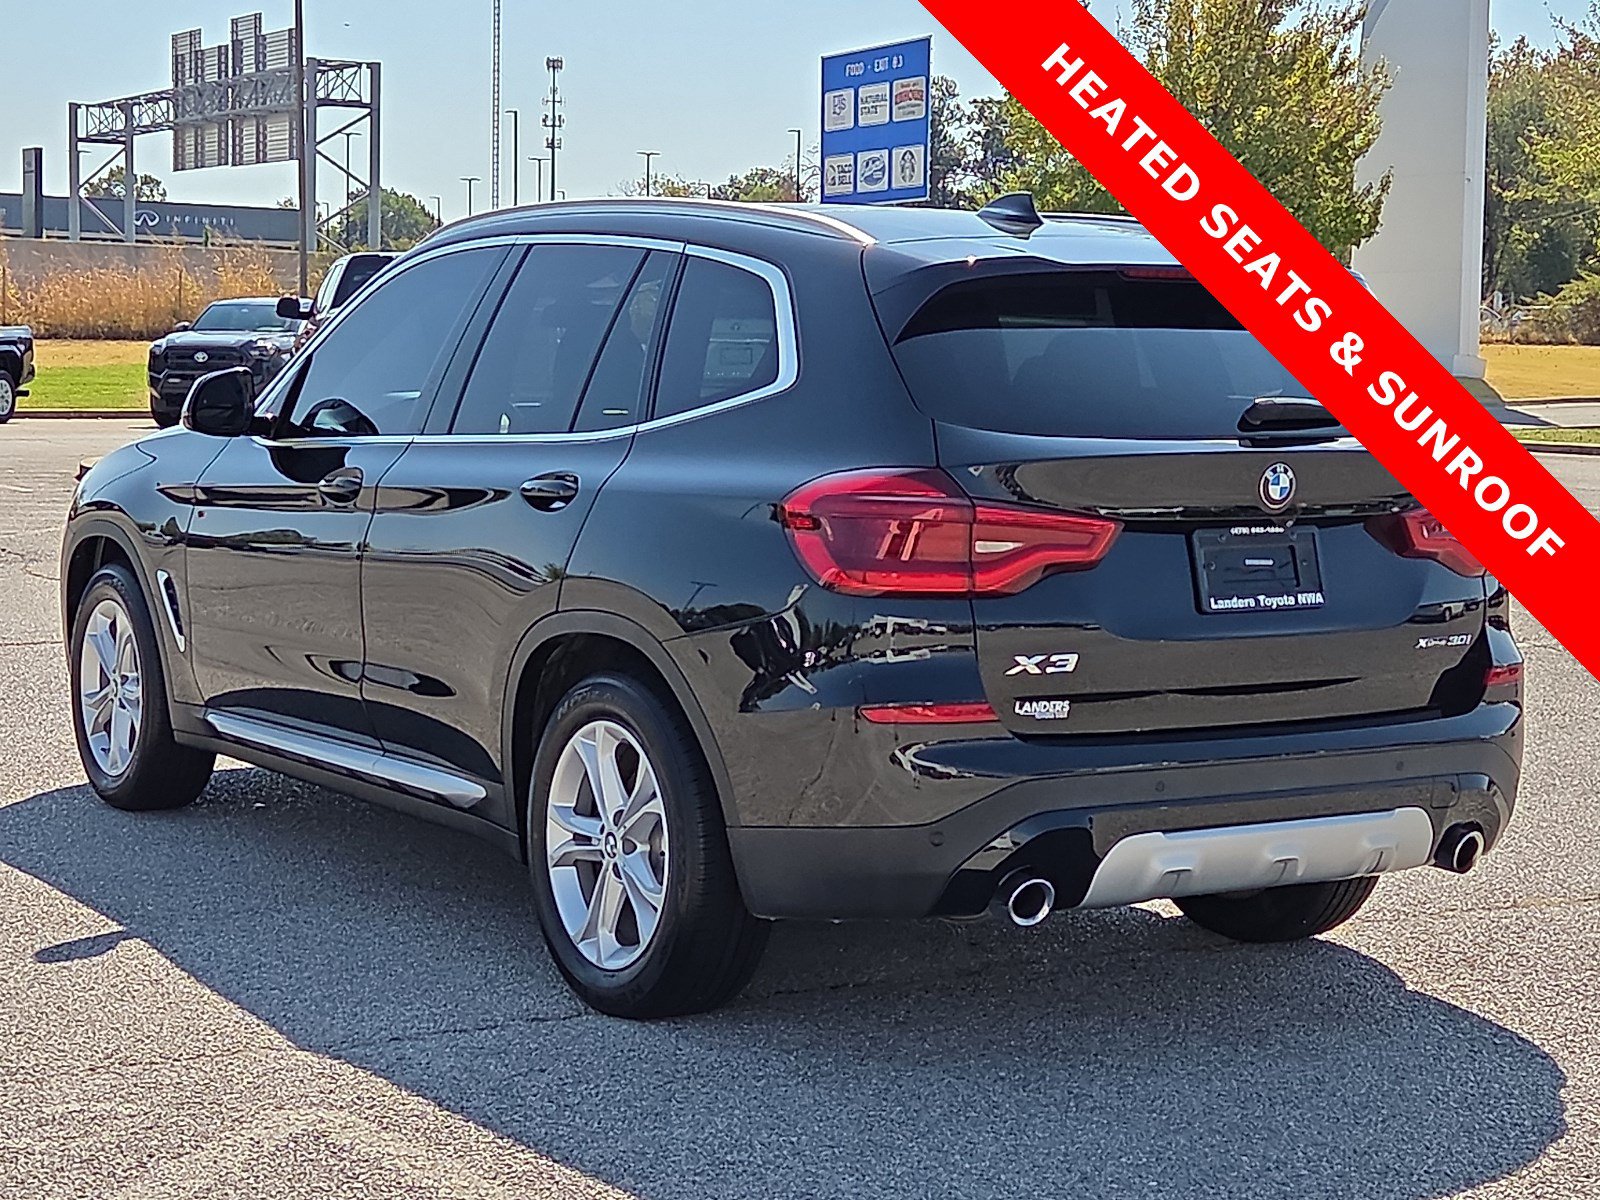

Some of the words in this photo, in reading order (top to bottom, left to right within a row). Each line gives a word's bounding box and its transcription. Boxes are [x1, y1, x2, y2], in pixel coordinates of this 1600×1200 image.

[845, 62, 865, 77] FOOD
[874, 56, 889, 72] EXIT
[837, 163, 853, 175] TACO
[837, 174, 852, 186] BELL
[166, 214, 235, 226] INFINITI
[1209, 596, 1256, 610] Landers
[1256, 593, 1296, 610] Toyota
[1297, 592, 1325, 605] NWA
[1004, 653, 1079, 676] X3
[1014, 700, 1071, 714] LANDERS
